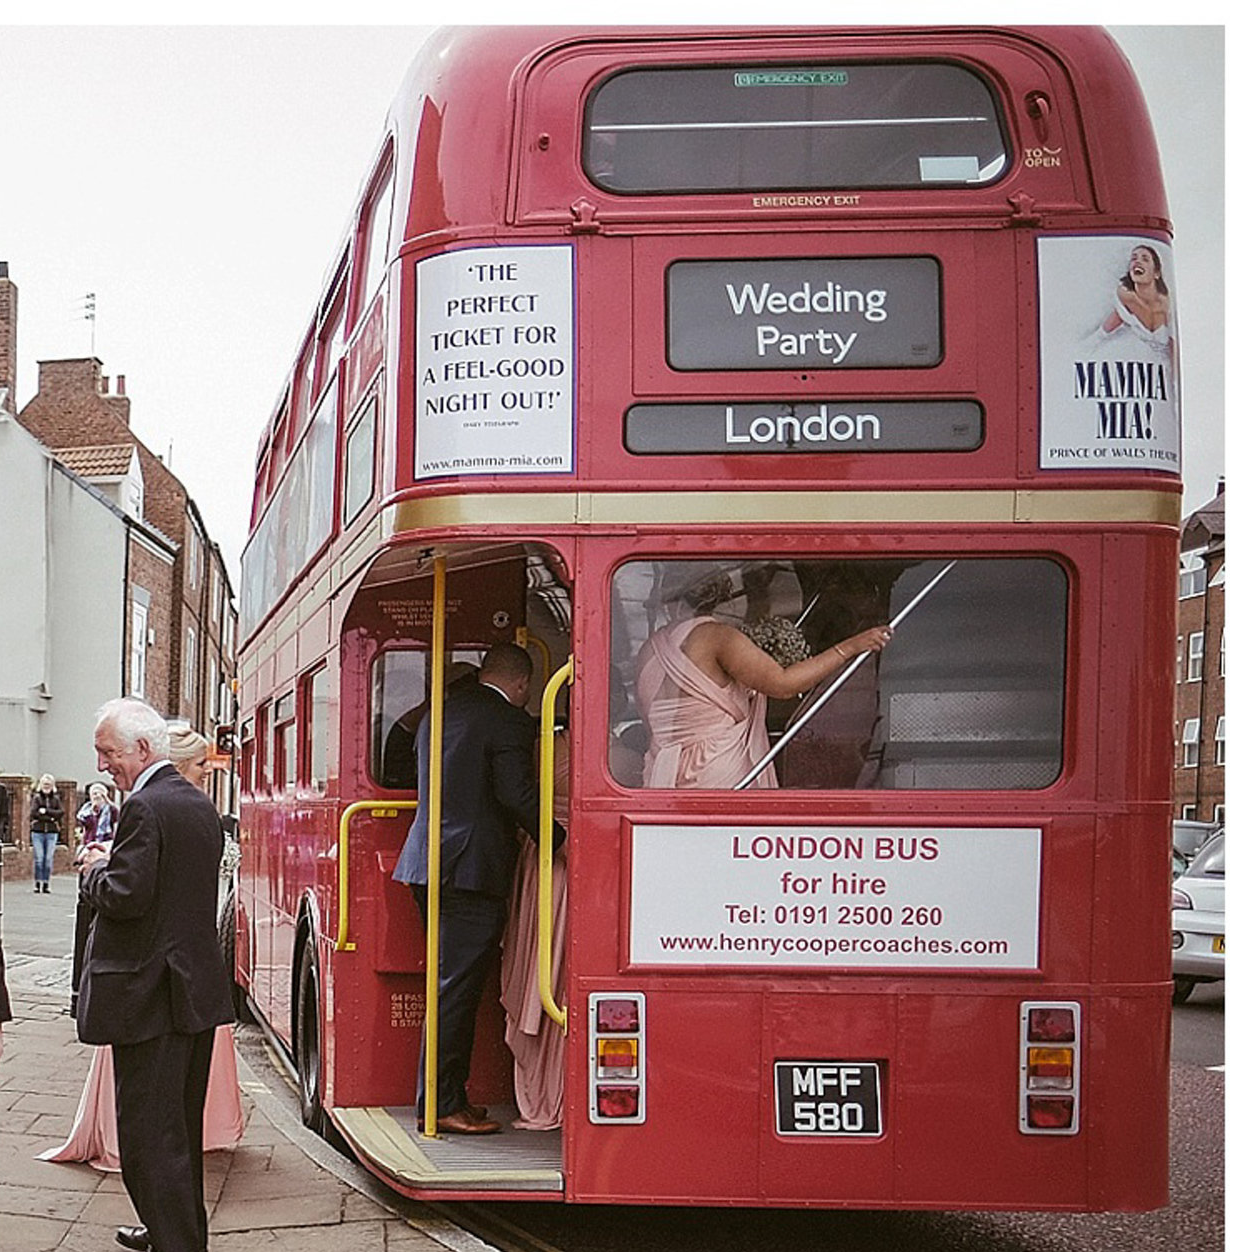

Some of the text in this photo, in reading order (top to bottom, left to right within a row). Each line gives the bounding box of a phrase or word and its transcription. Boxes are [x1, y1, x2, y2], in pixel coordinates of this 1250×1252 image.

[1024, 148, 1043, 158] TO
[1024, 157, 1060, 168] OPEN
[753, 195, 860, 208] EMERGENCY EXIT
[447, 294, 539, 317] PERFECT
[726, 281, 888, 322] Wedding
[431, 326, 557, 351] TICKET FOR
[757, 325, 857, 364] Party
[422, 359, 565, 386] A FEEL-GOOD
[1074, 361, 1167, 401] MAMMA
[425, 392, 492, 417] NIGHT
[725, 405, 881, 443] London
[1096, 401, 1153, 440] MIA!
[422, 454, 563, 472] www.mamma-mia.com
[1050, 447, 1090, 459] PRINCE
[1093, 447, 1107, 459] OF
[1111, 447, 1146, 459] WALES
[732, 836, 940, 861] LONDON BUS
[780, 871, 887, 895] for hire
[725, 904, 943, 927] Tel: 0191 2500 260
[659, 932, 1010, 956] www.henrycoopercoaches.com
[793, 1067, 861, 1096] MFF
[794, 1102, 863, 1131] 580
